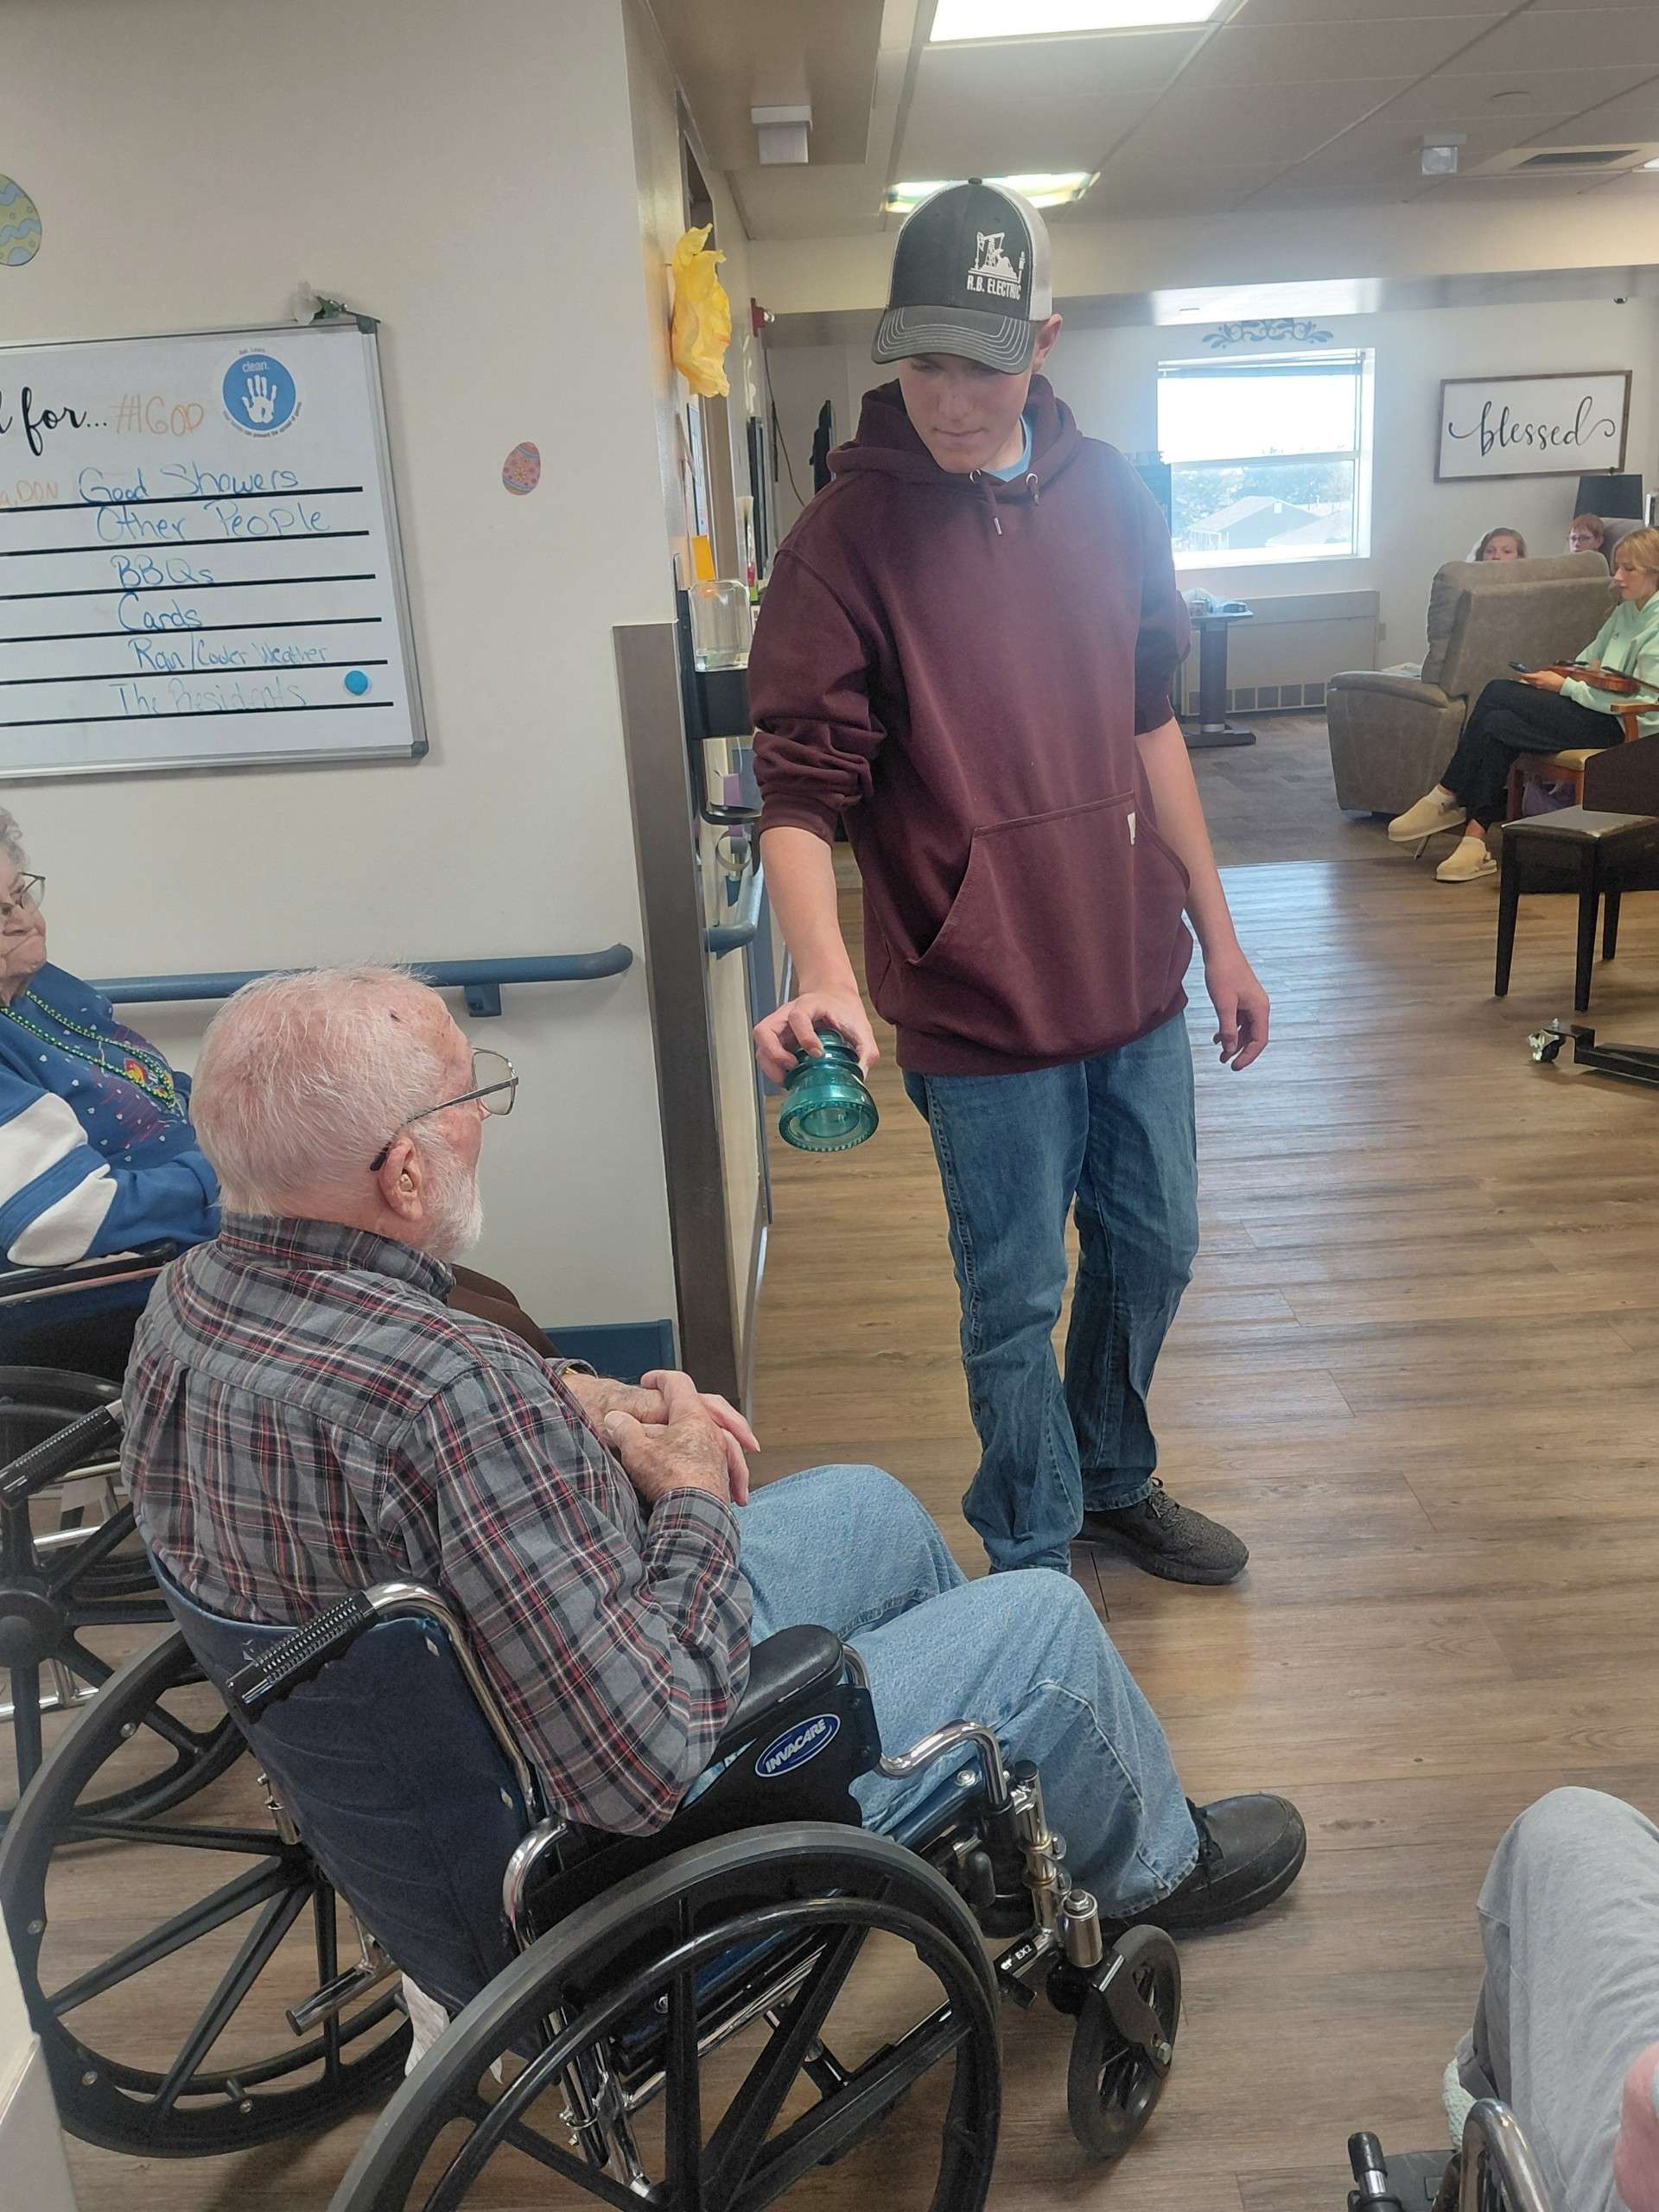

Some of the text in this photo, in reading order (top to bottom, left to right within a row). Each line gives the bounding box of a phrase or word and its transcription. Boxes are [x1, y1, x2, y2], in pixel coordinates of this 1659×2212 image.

[967, 275, 1021, 301] R.B. ELECTRIC
[1448, 396, 1616, 456] blessed
[160, 461, 299, 496] Showers
[97, 499, 332, 542] Other People
[111, 554, 213, 589] BBQs
[118, 591, 202, 632] Cards
[766, 1719, 827, 1773] INVACARE
[1014, 1944, 1032, 1960] EX2
